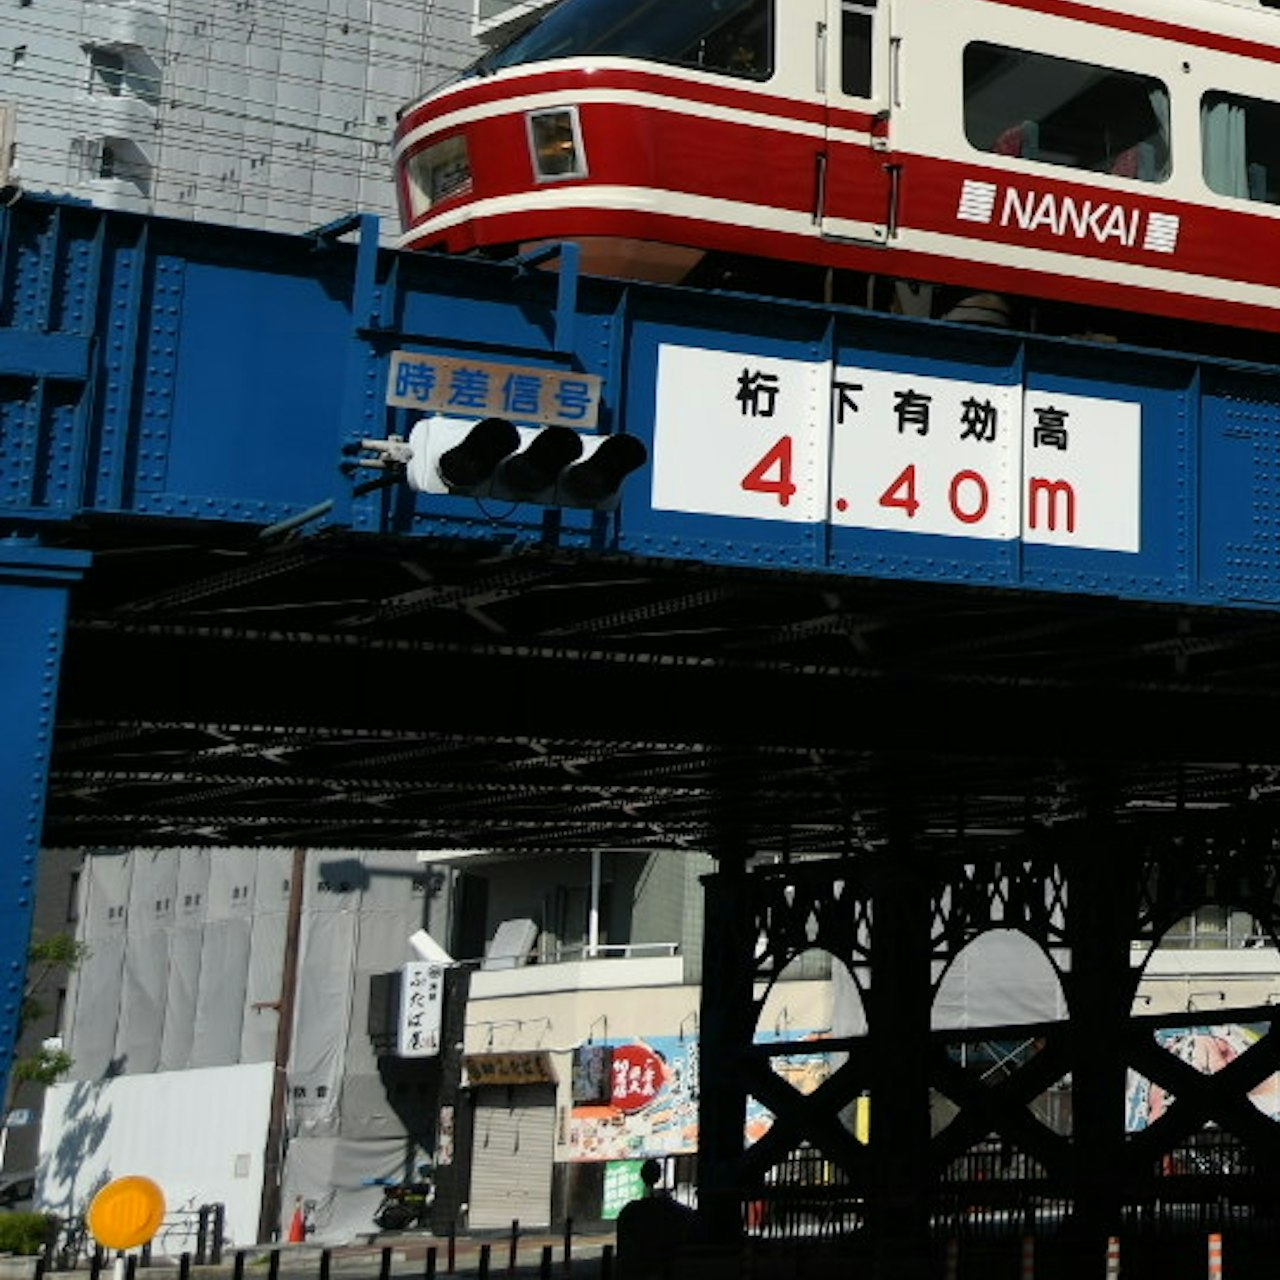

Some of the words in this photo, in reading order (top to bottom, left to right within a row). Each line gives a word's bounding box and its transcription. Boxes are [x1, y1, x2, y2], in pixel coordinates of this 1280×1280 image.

[1000, 187, 1140, 247] NANKAI
[396, 362, 591, 420] 時差信号
[736, 368, 1070, 451] 桁下有効高
